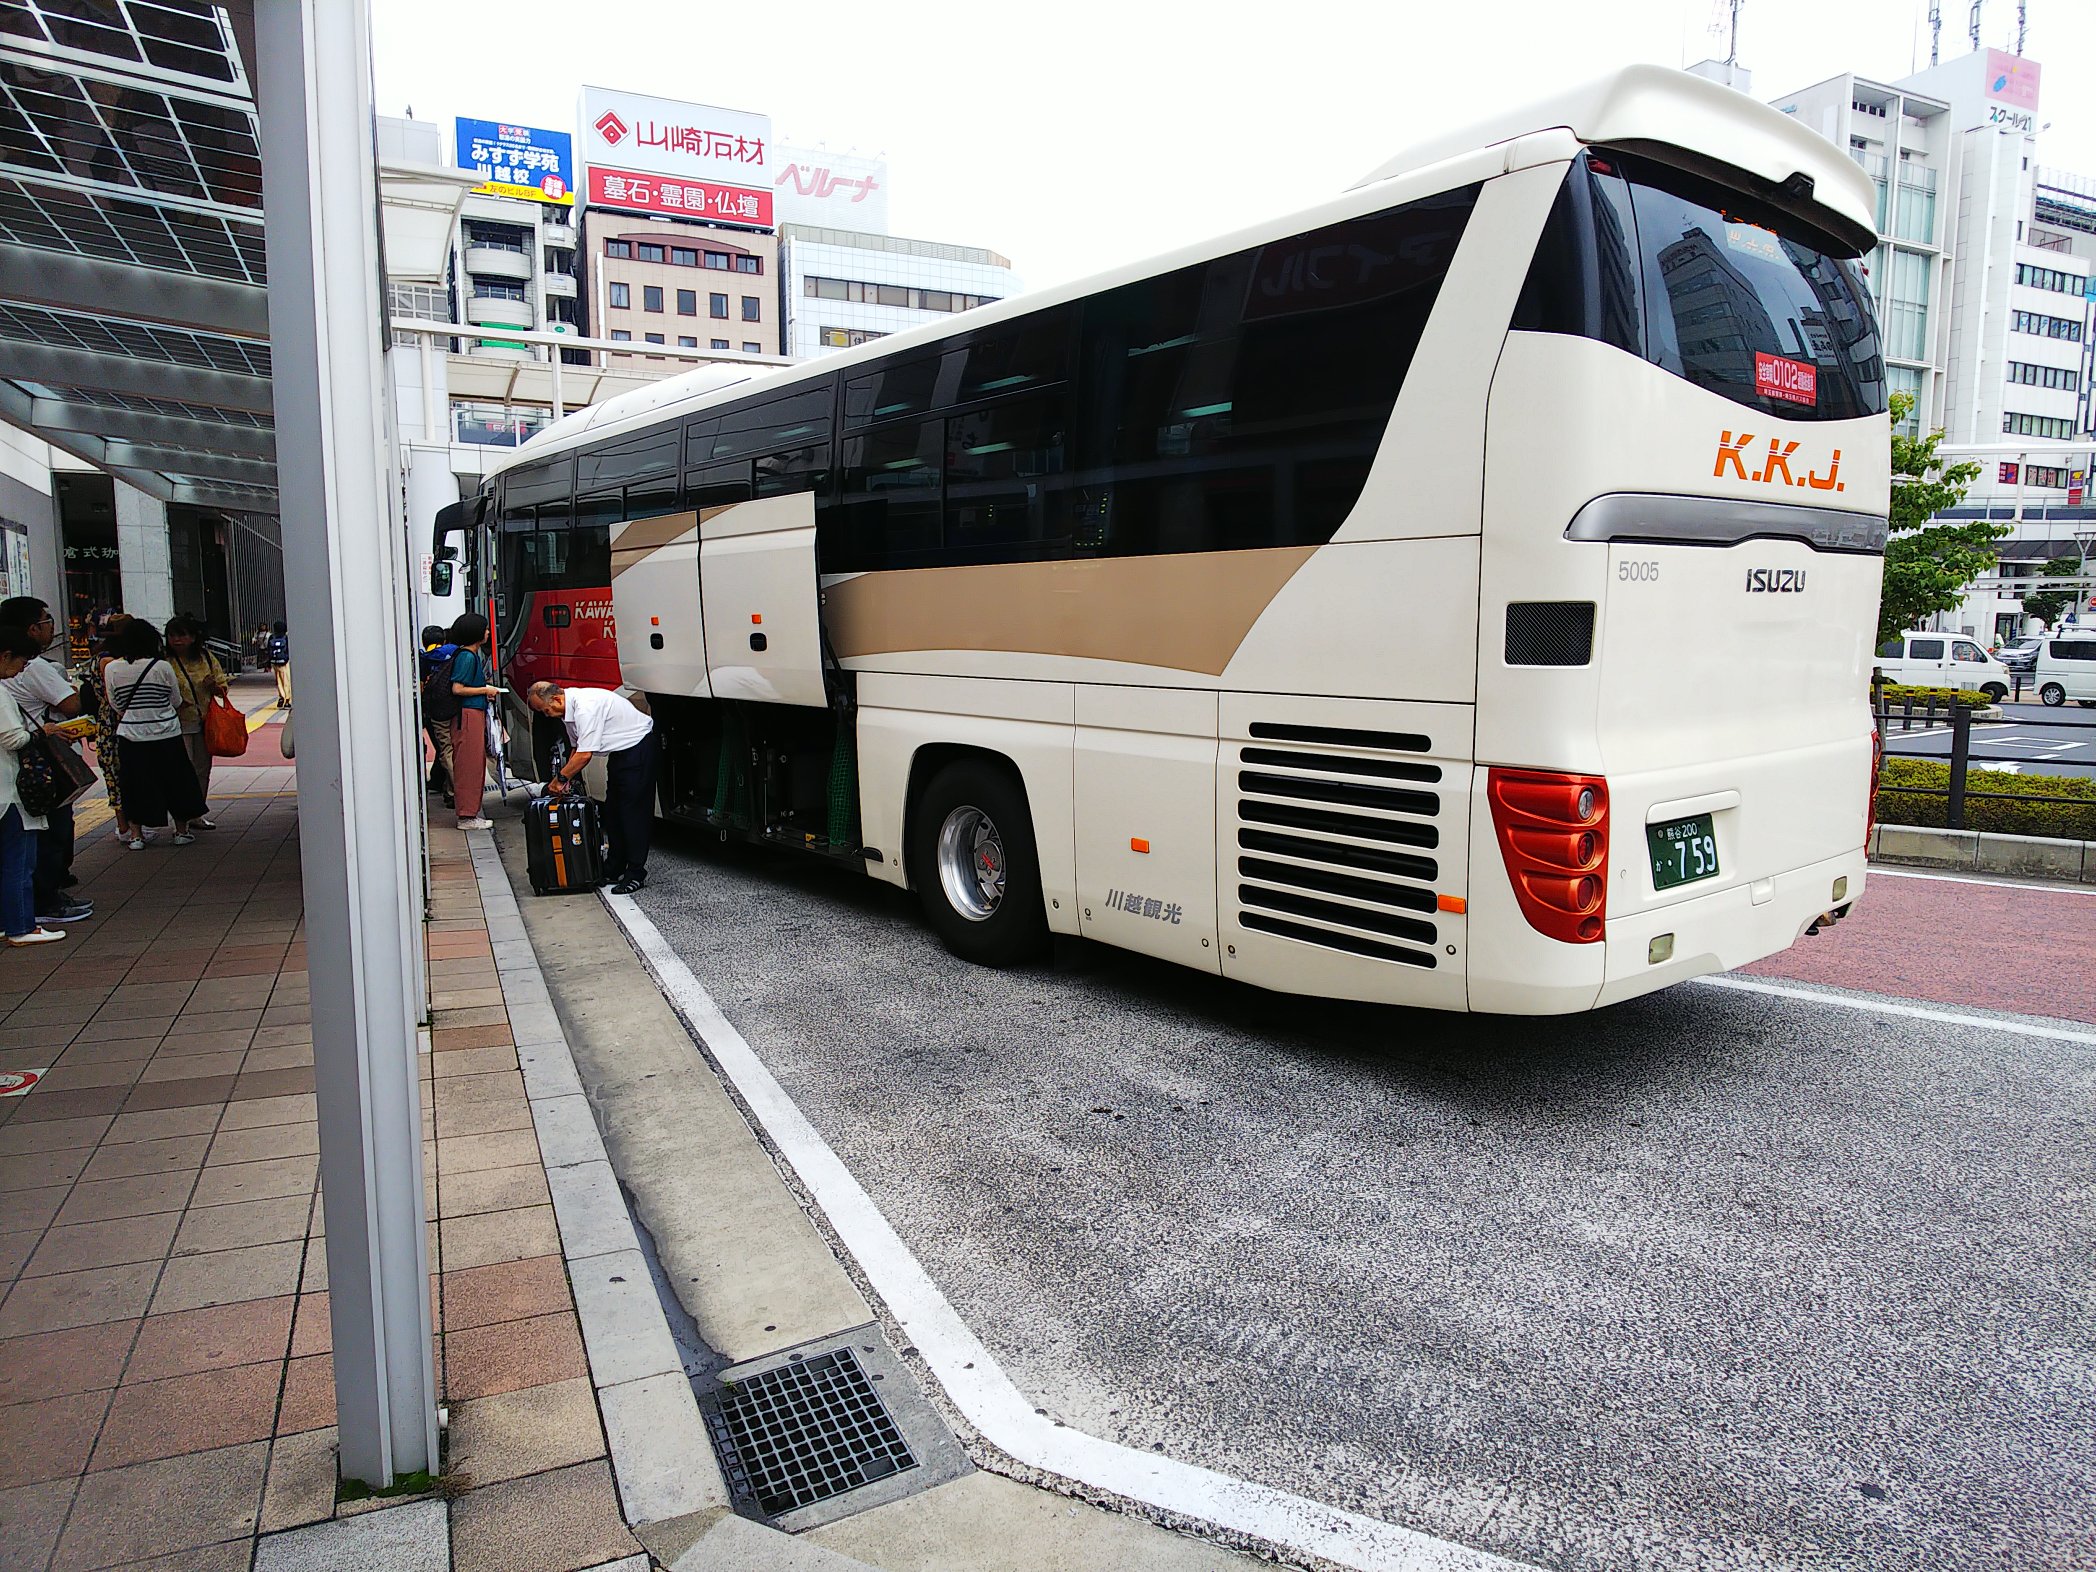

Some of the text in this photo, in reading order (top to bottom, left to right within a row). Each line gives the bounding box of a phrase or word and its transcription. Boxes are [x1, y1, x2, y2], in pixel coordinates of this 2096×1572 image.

[1989, 106, 2032, 132] スクール21
[635, 120, 766, 166] 山崎石材
[471, 143, 560, 173] みすず学苑
[476, 162, 530, 185] 川越校
[775, 163, 880, 203] ベルーナ
[603, 174, 760, 219] 墓石・霊園・仏壇
[1713, 430, 1846, 492] K.K.J.
[1618, 561, 1660, 582] 5005
[1745, 568, 1807, 593] ISUZU
[603, 620, 616, 639] K
[1682, 822, 1698, 838] 200
[1105, 888, 1182, 925] 川越観光
